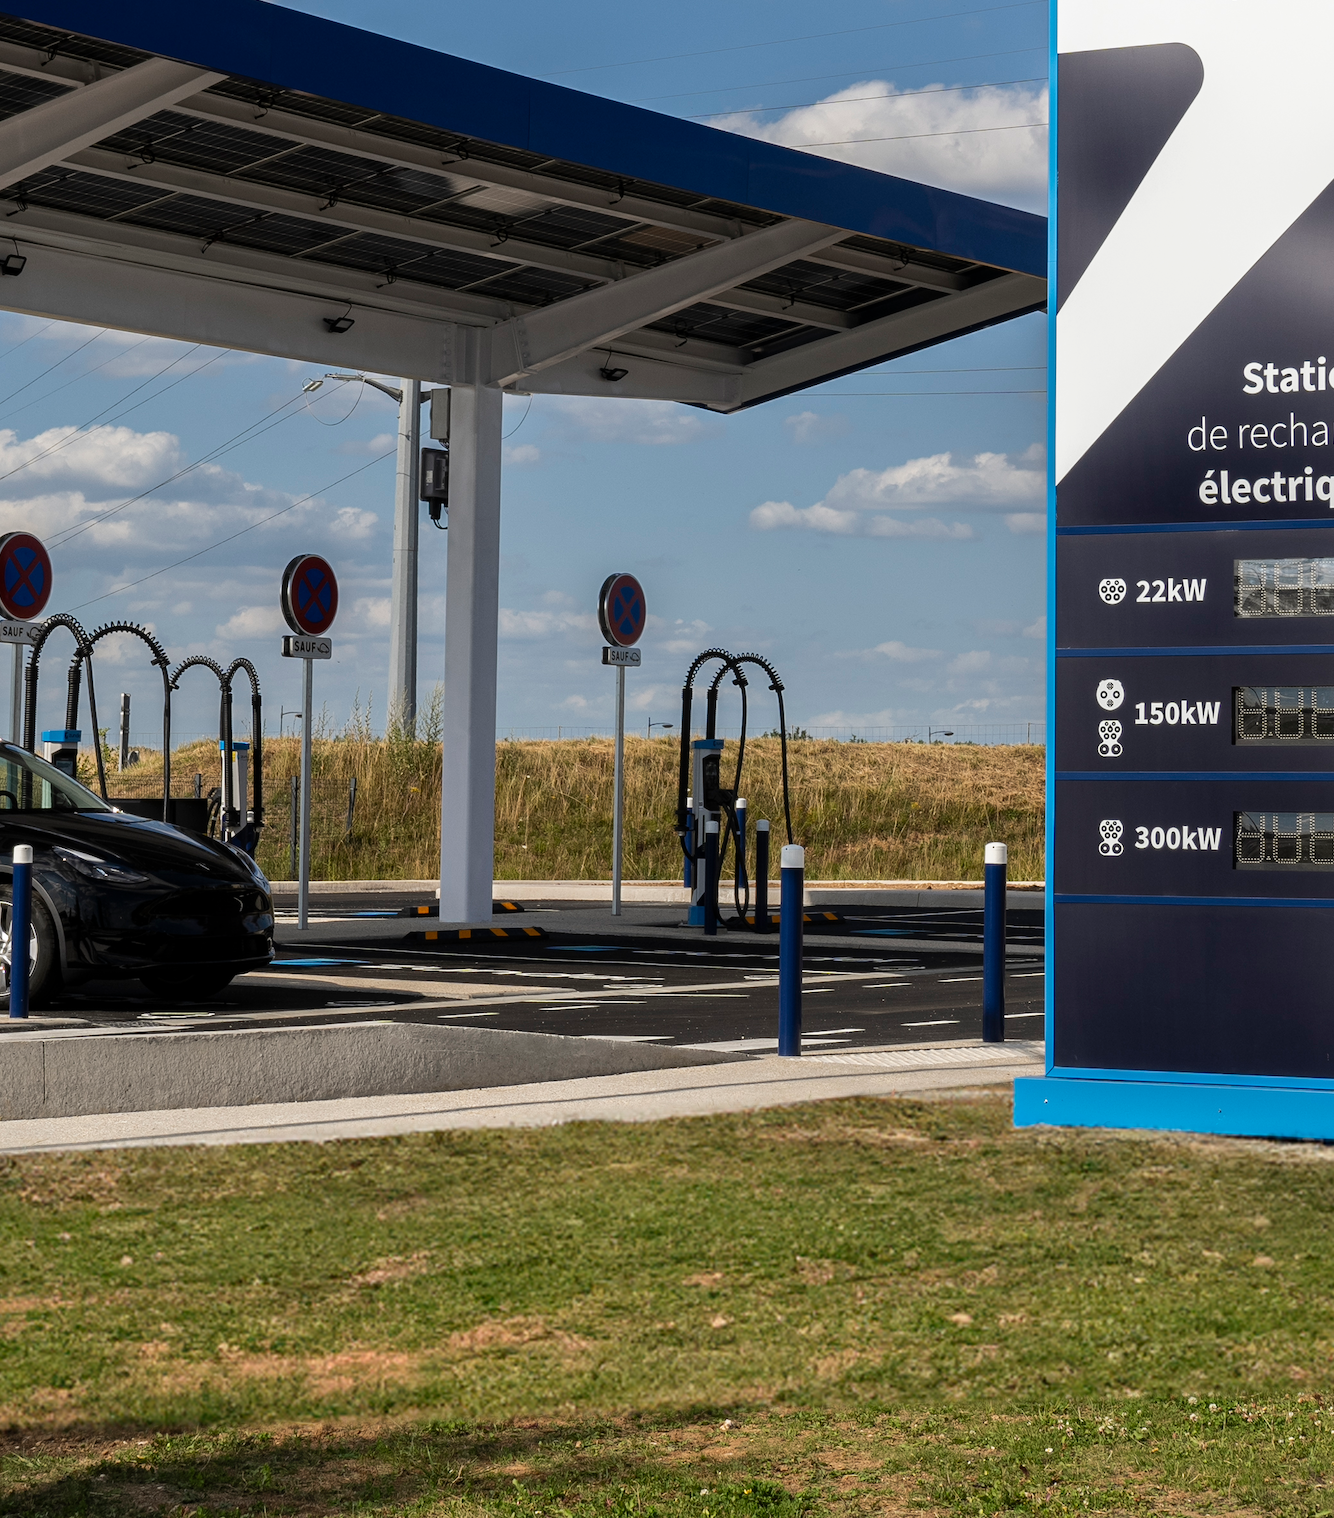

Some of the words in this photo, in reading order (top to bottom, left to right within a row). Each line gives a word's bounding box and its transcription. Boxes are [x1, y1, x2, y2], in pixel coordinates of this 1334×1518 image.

[1187, 416, 1228, 451] de
[1135, 578, 1207, 603] 22kW
[2, 626, 24, 637] SAUF
[294, 641, 316, 653] SAUF
[611, 651, 629, 661] SAUF
[1134, 700, 1221, 725] 150kW
[1134, 826, 1222, 850] 300kW
